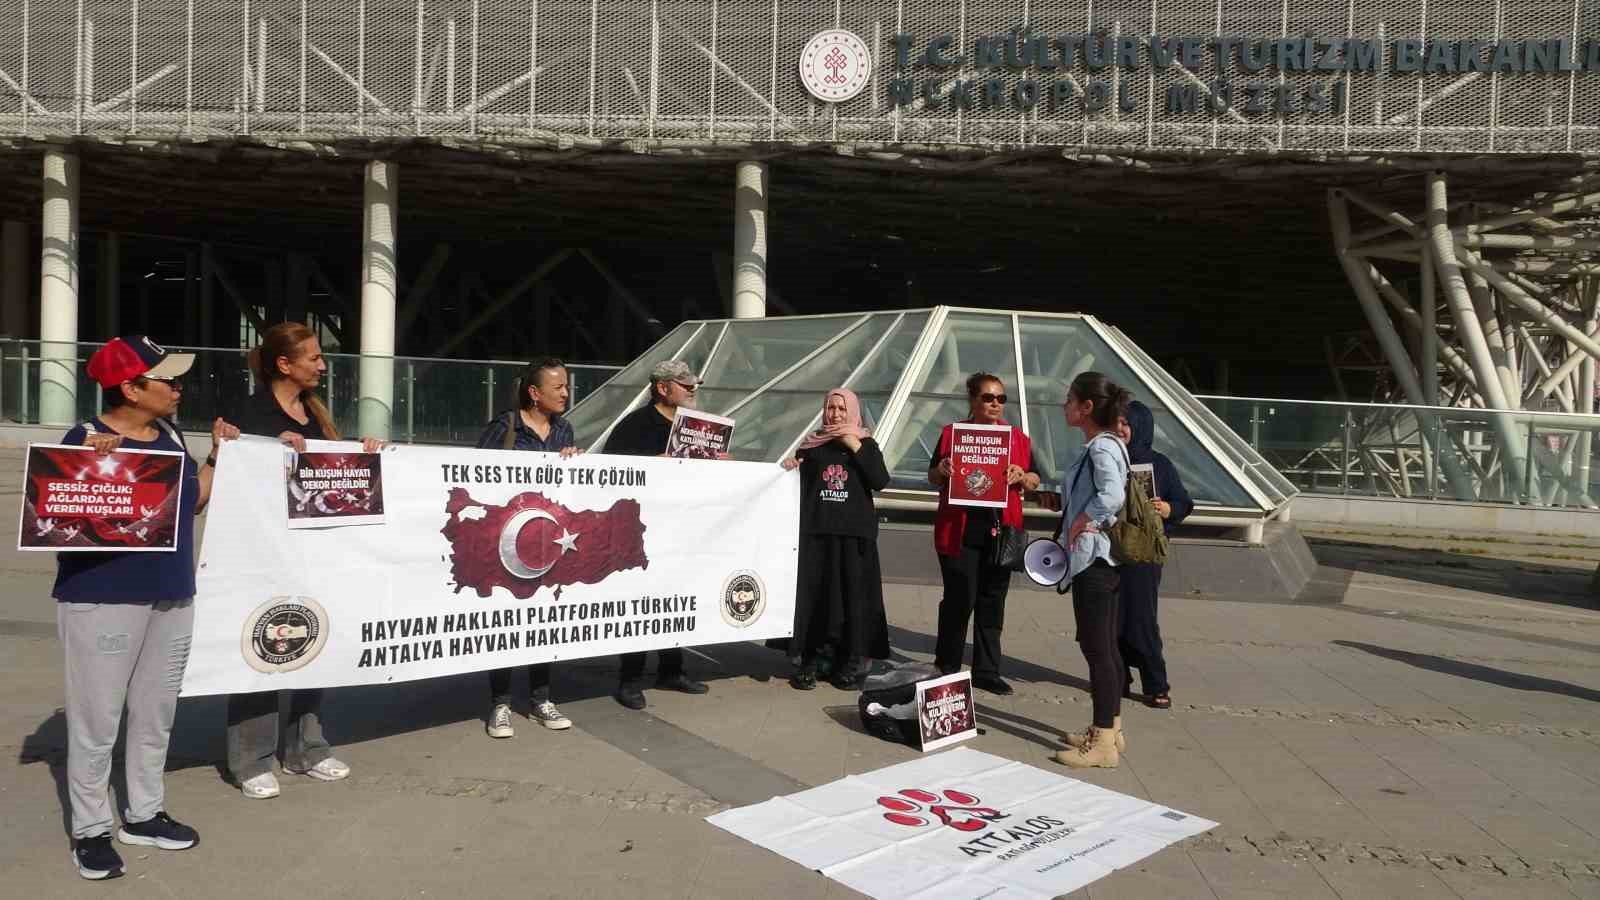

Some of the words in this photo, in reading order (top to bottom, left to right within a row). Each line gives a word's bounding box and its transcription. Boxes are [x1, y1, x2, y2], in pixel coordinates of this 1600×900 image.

[974, 25, 1138, 69] KÜLTÜR
[1149, 34, 1203, 69] VE
[1211, 28, 1382, 72] TURİZM
[888, 78, 1139, 113] NEKROPOL
[1168, 73, 1347, 114] MÜZESİ
[961, 433, 974, 444] BİR
[975, 435, 1002, 446] KUŞUN
[954, 445, 980, 454] HAYATI
[981, 447, 1008, 456] DEKOR
[961, 454, 999, 465] DEĞİLDİR!
[299, 467, 314, 478] BİR
[315, 468, 342, 480] KUŞUN
[344, 468, 370, 478] HAYATI
[441, 464, 470, 483] TEK
[474, 465, 502, 484] SES
[506, 466, 532, 484] TEK
[535, 465, 564, 488] GÜÇ
[568, 468, 595, 485] TEK
[599, 467, 646, 488] ÇÖZÜM
[47, 481, 89, 492] SESSİZ
[91, 483, 133, 495] ÇIĞLIK:
[302, 480, 330, 490] DEKOR
[331, 478, 369, 489] DEĞİLDİR!
[47, 492, 105, 504] AĞLARDA
[107, 495, 131, 504] CAN
[820, 490, 848, 498] ATTALOS
[45, 504, 84, 513] VEREN
[86, 505, 134, 516] KUŞLAR!
[361, 615, 437, 642] HAYVAN
[443, 608, 521, 633] HAKLARI
[527, 600, 626, 625] PLATFORMU
[631, 594, 697, 616] TÜRKİYE
[358, 639, 443, 668] ANTALYA
[449, 631, 520, 657] HAYVAN
[525, 624, 599, 648] HAKLARI
[604, 615, 696, 639] PLATFORMU
[958, 815, 1064, 857] ATTALOS
